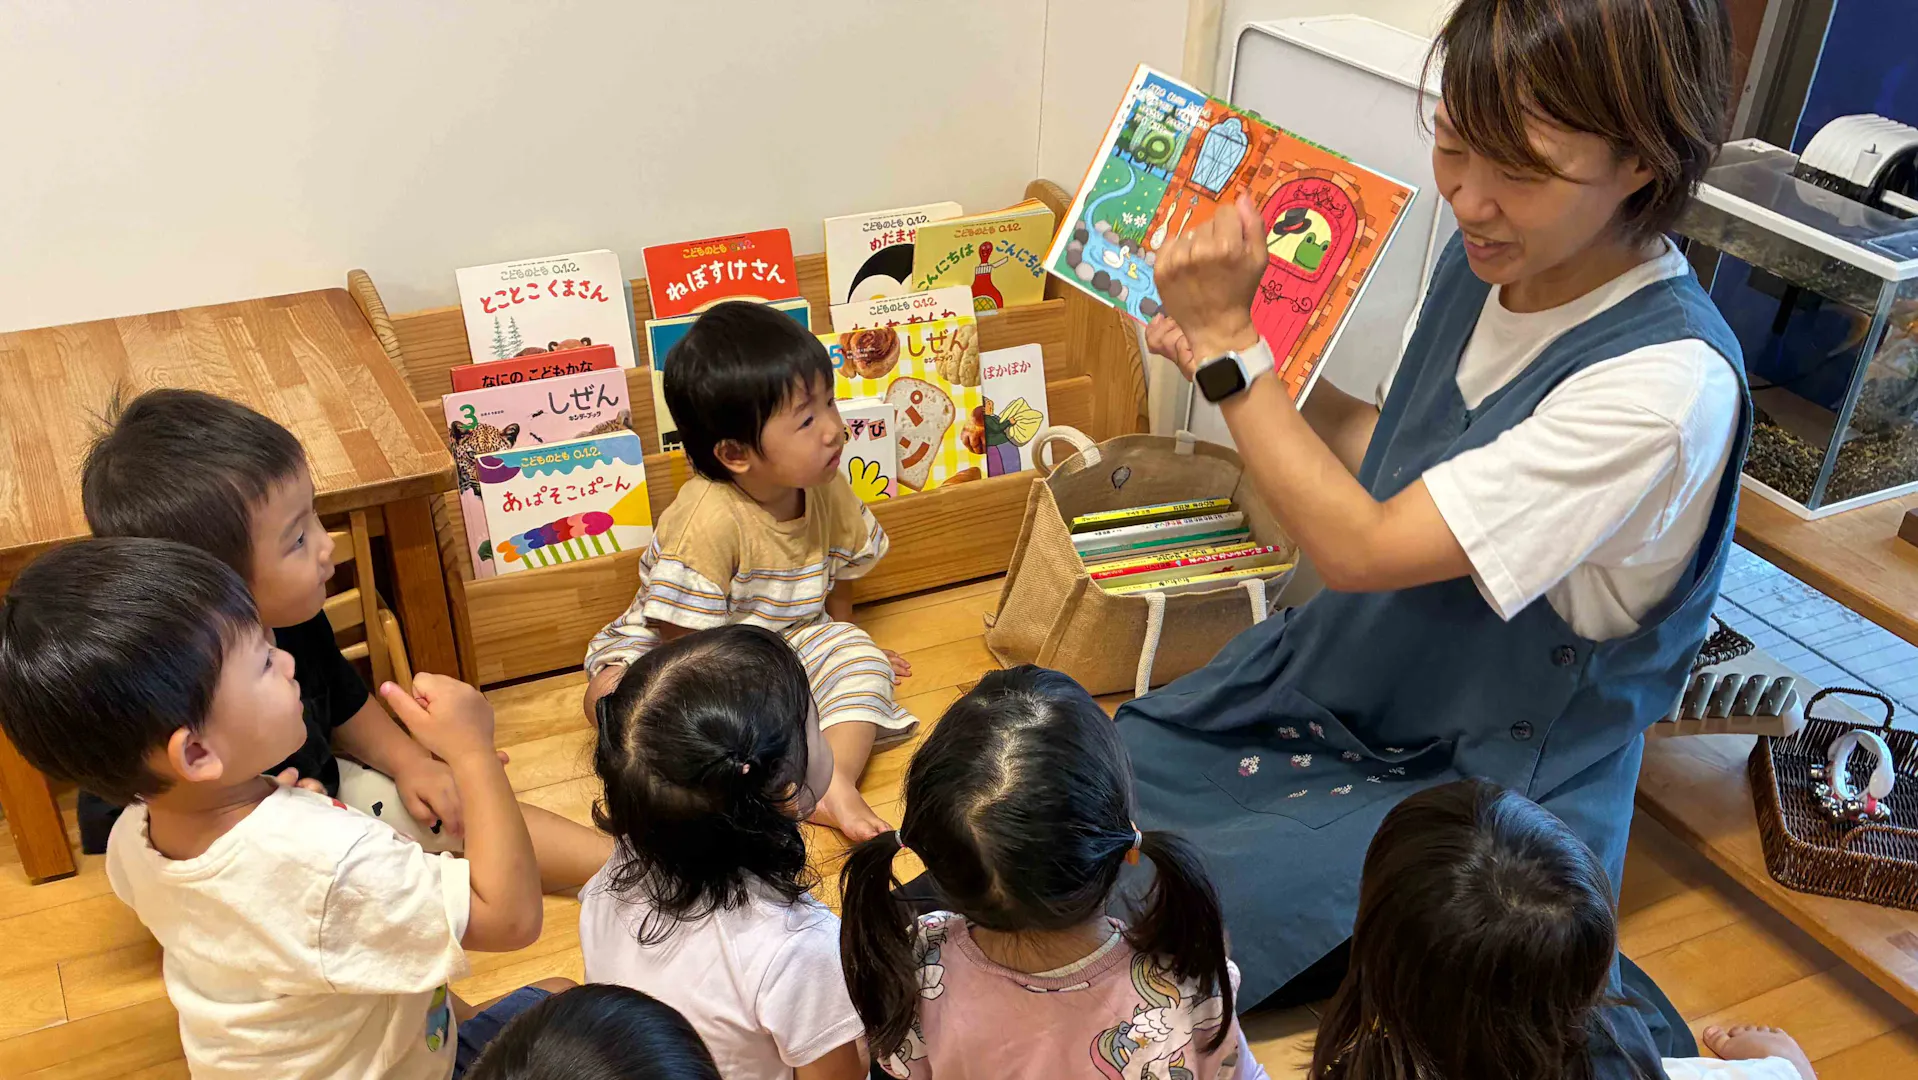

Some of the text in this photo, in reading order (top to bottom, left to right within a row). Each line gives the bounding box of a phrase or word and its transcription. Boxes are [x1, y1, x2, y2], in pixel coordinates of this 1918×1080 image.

[862, 218, 904, 232] こどものとも
[954, 228, 996, 238] こどものとも
[682, 243, 728, 259] こどものとも
[500, 266, 549, 281] こどものとも
[918, 240, 1046, 290] こんにちは こんにちは
[666, 258, 786, 301] ねぼすけさん
[869, 301, 911, 316] こどものとも
[907, 329, 969, 358] しぜん
[829, 344, 845, 369] 5
[983, 360, 1031, 380] ぽかぽか
[548, 384, 619, 414] しぜん
[459, 404, 478, 430] 3
[568, 411, 602, 421] キンダーブック
[520, 452, 570, 468] こどものとも
[502, 476, 631, 513] あぱそこぱーん
